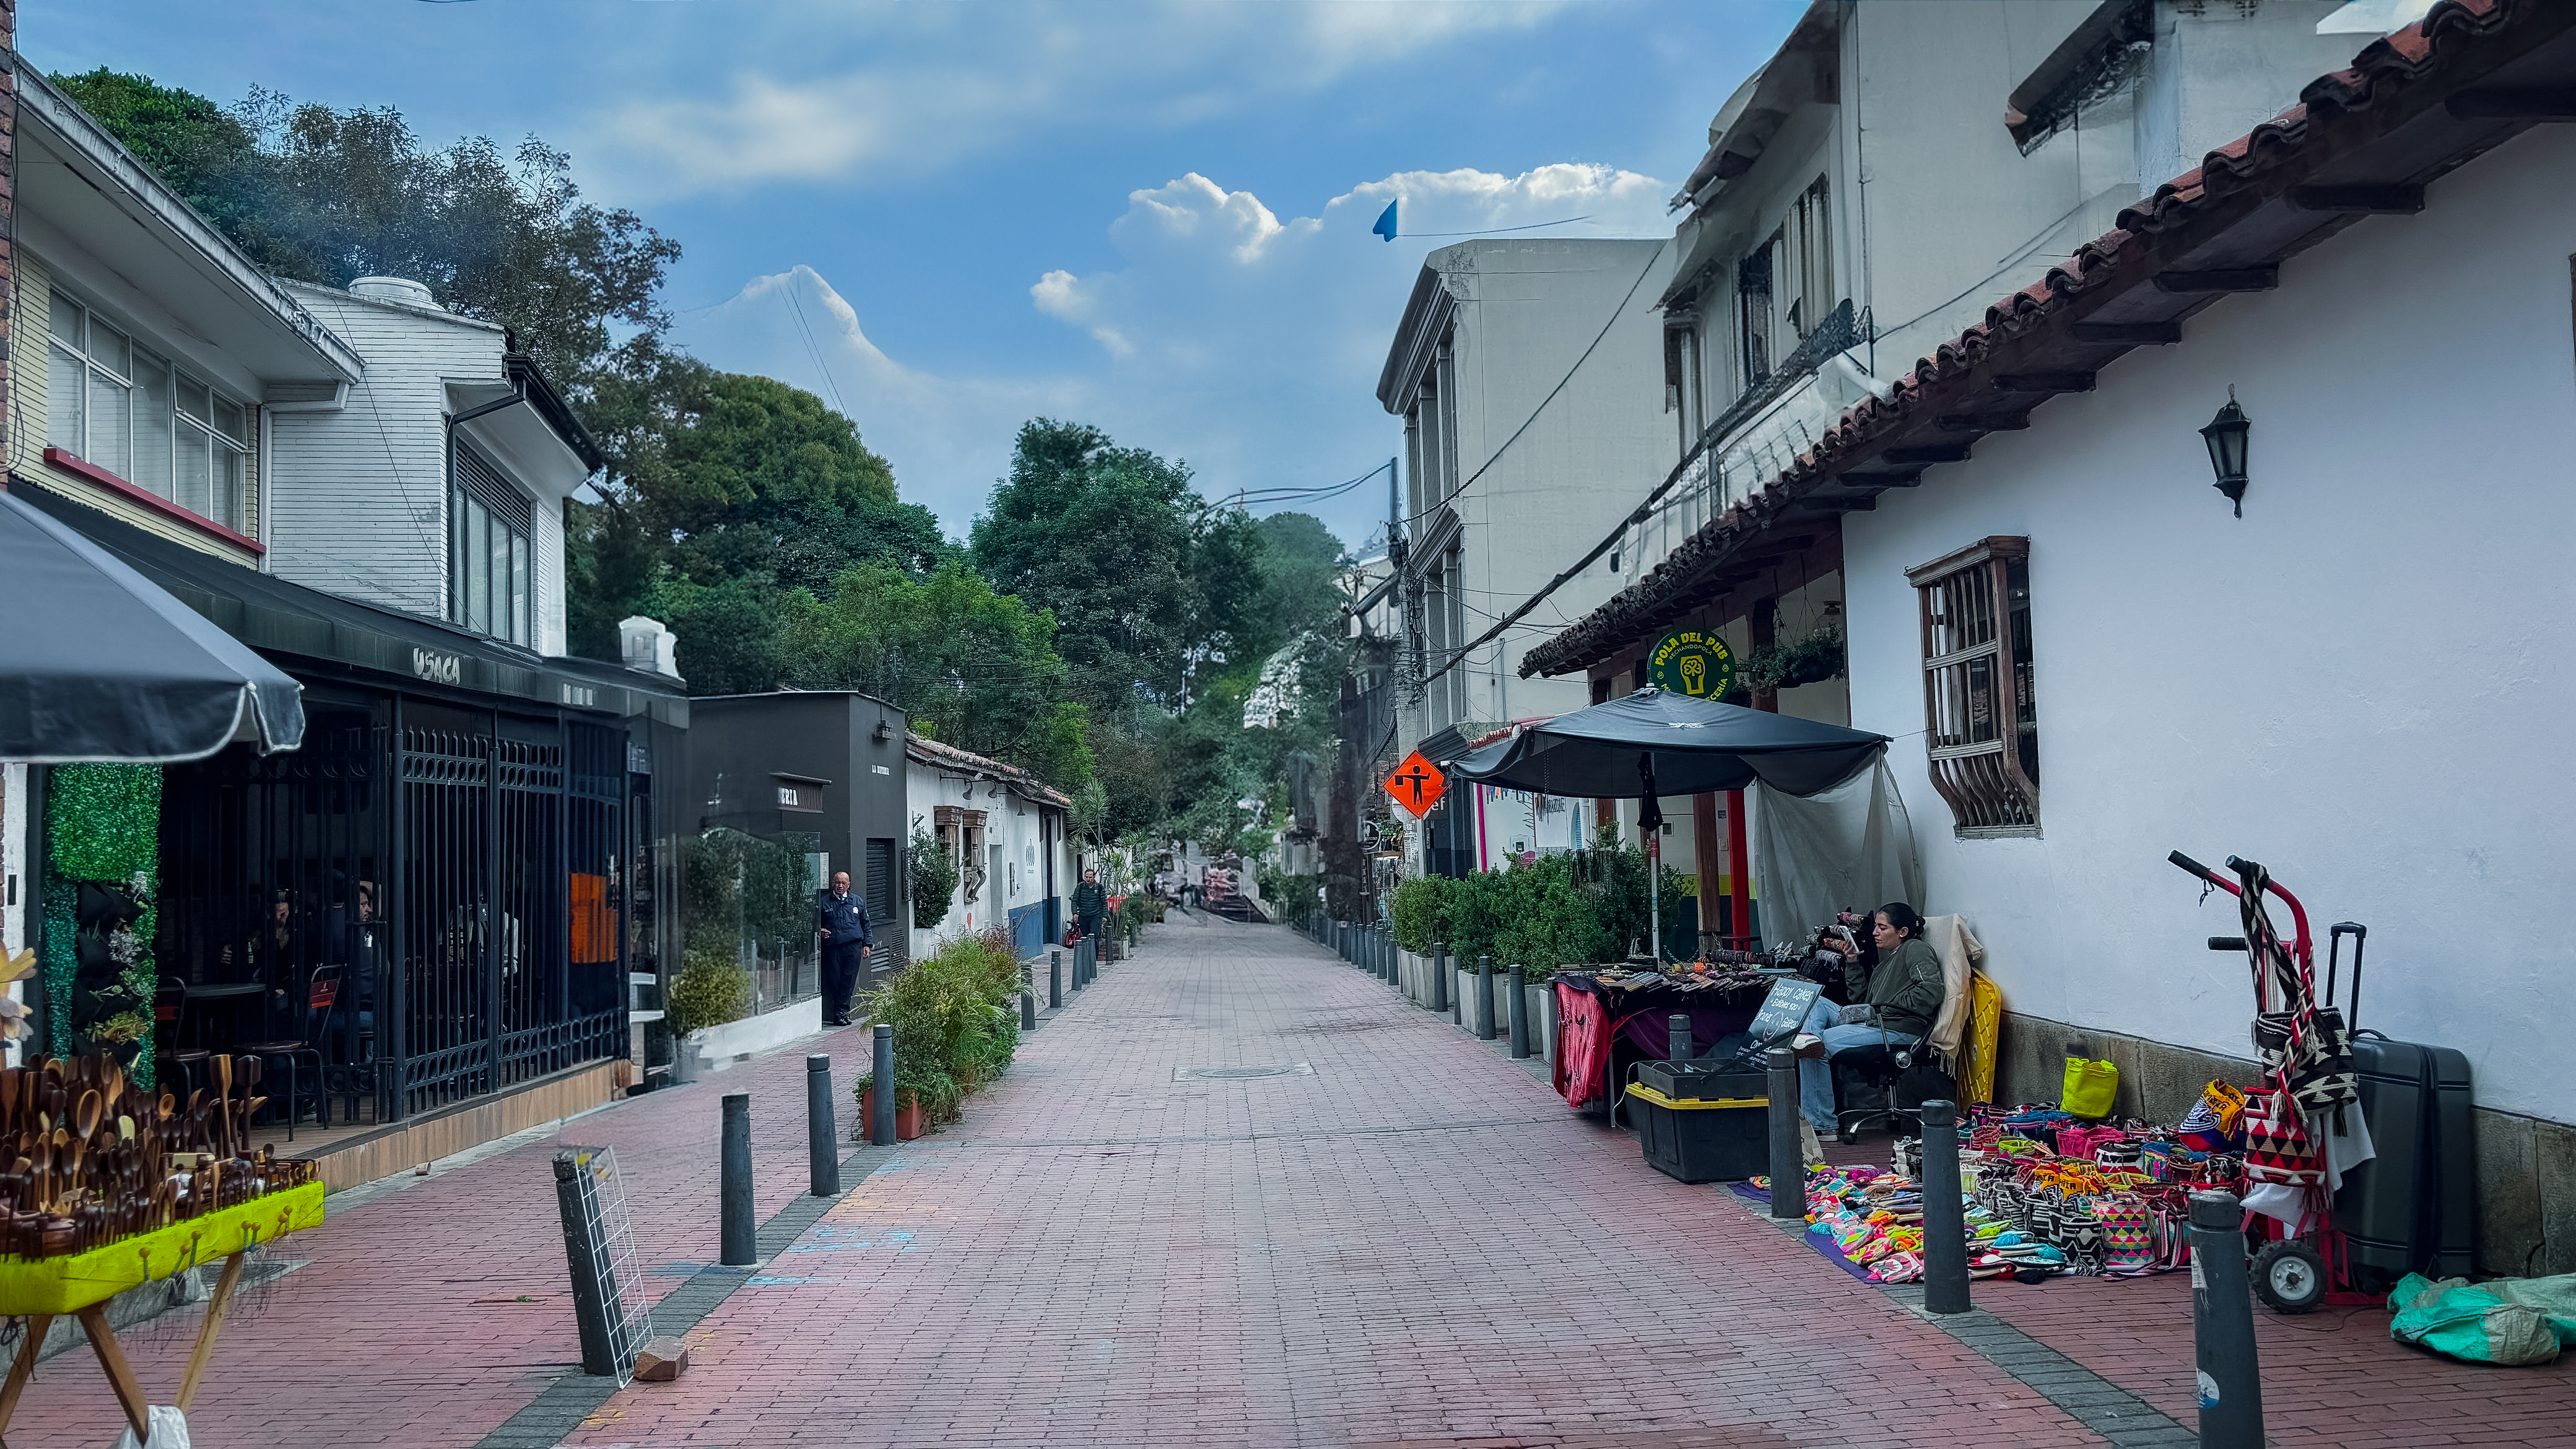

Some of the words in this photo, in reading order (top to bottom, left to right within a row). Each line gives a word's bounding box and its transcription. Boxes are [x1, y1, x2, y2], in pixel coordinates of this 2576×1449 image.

[1655, 637, 1679, 666] POLA
[1681, 632, 1703, 643] DEL
[1705, 637, 1728, 659] PUB
[413, 647, 461, 685] USACA
[1430, 796, 1446, 811] ef
[1771, 982, 1795, 998] Happy
